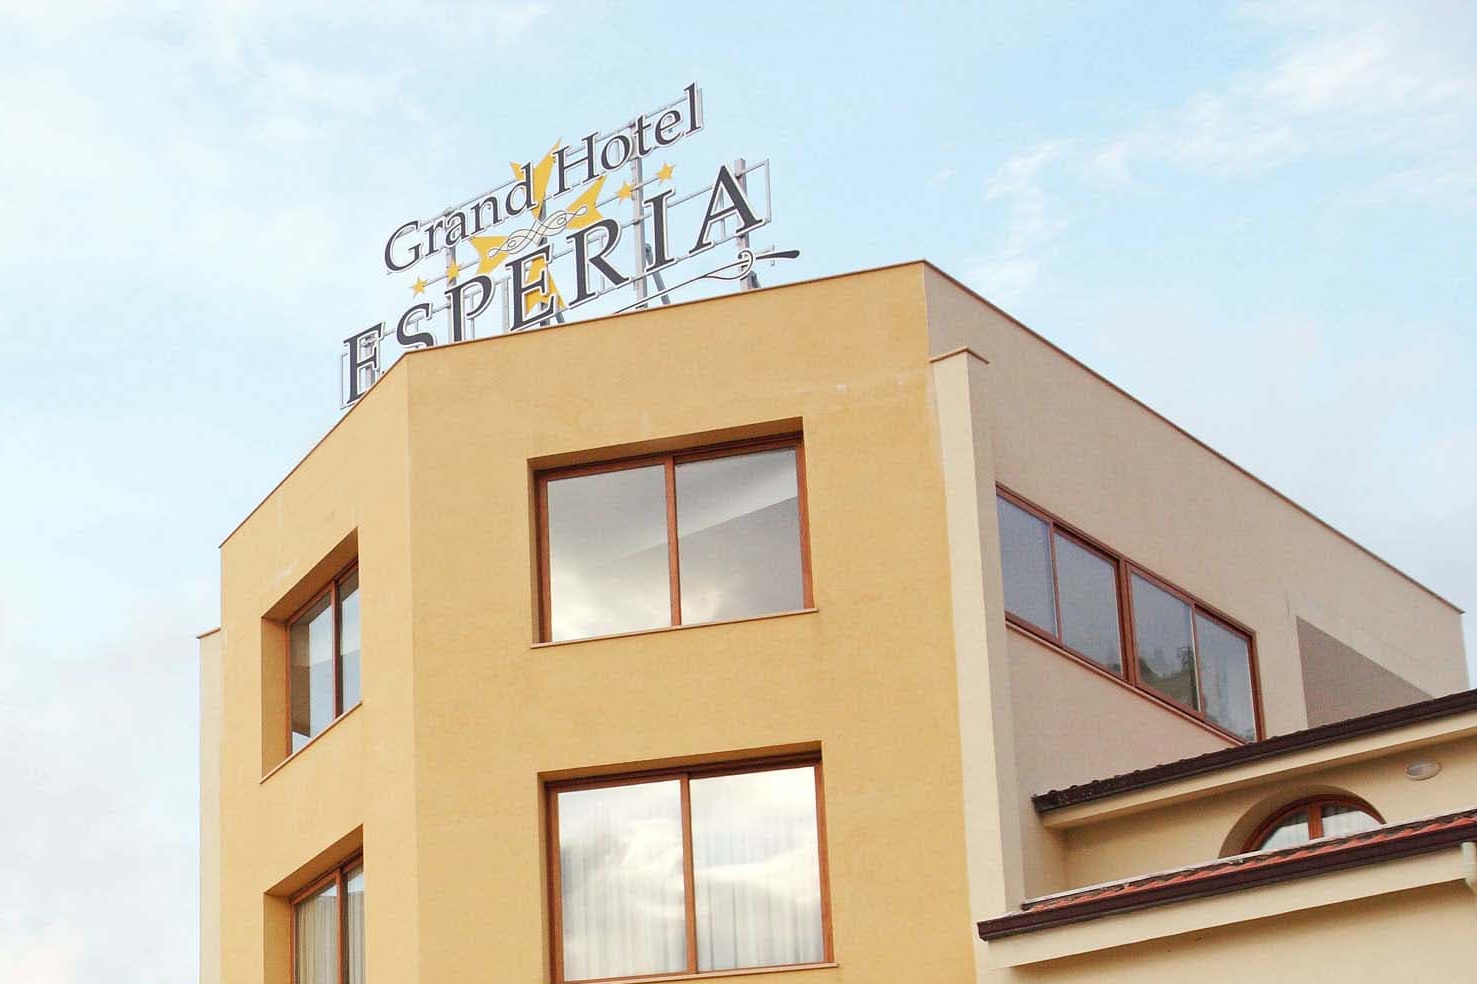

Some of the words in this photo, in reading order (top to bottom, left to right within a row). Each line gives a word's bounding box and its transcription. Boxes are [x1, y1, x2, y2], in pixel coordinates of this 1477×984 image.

[343, 164, 765, 406] ESPERIA
[385, 162, 536, 274] Grand
[553, 81, 702, 195] Hotel
